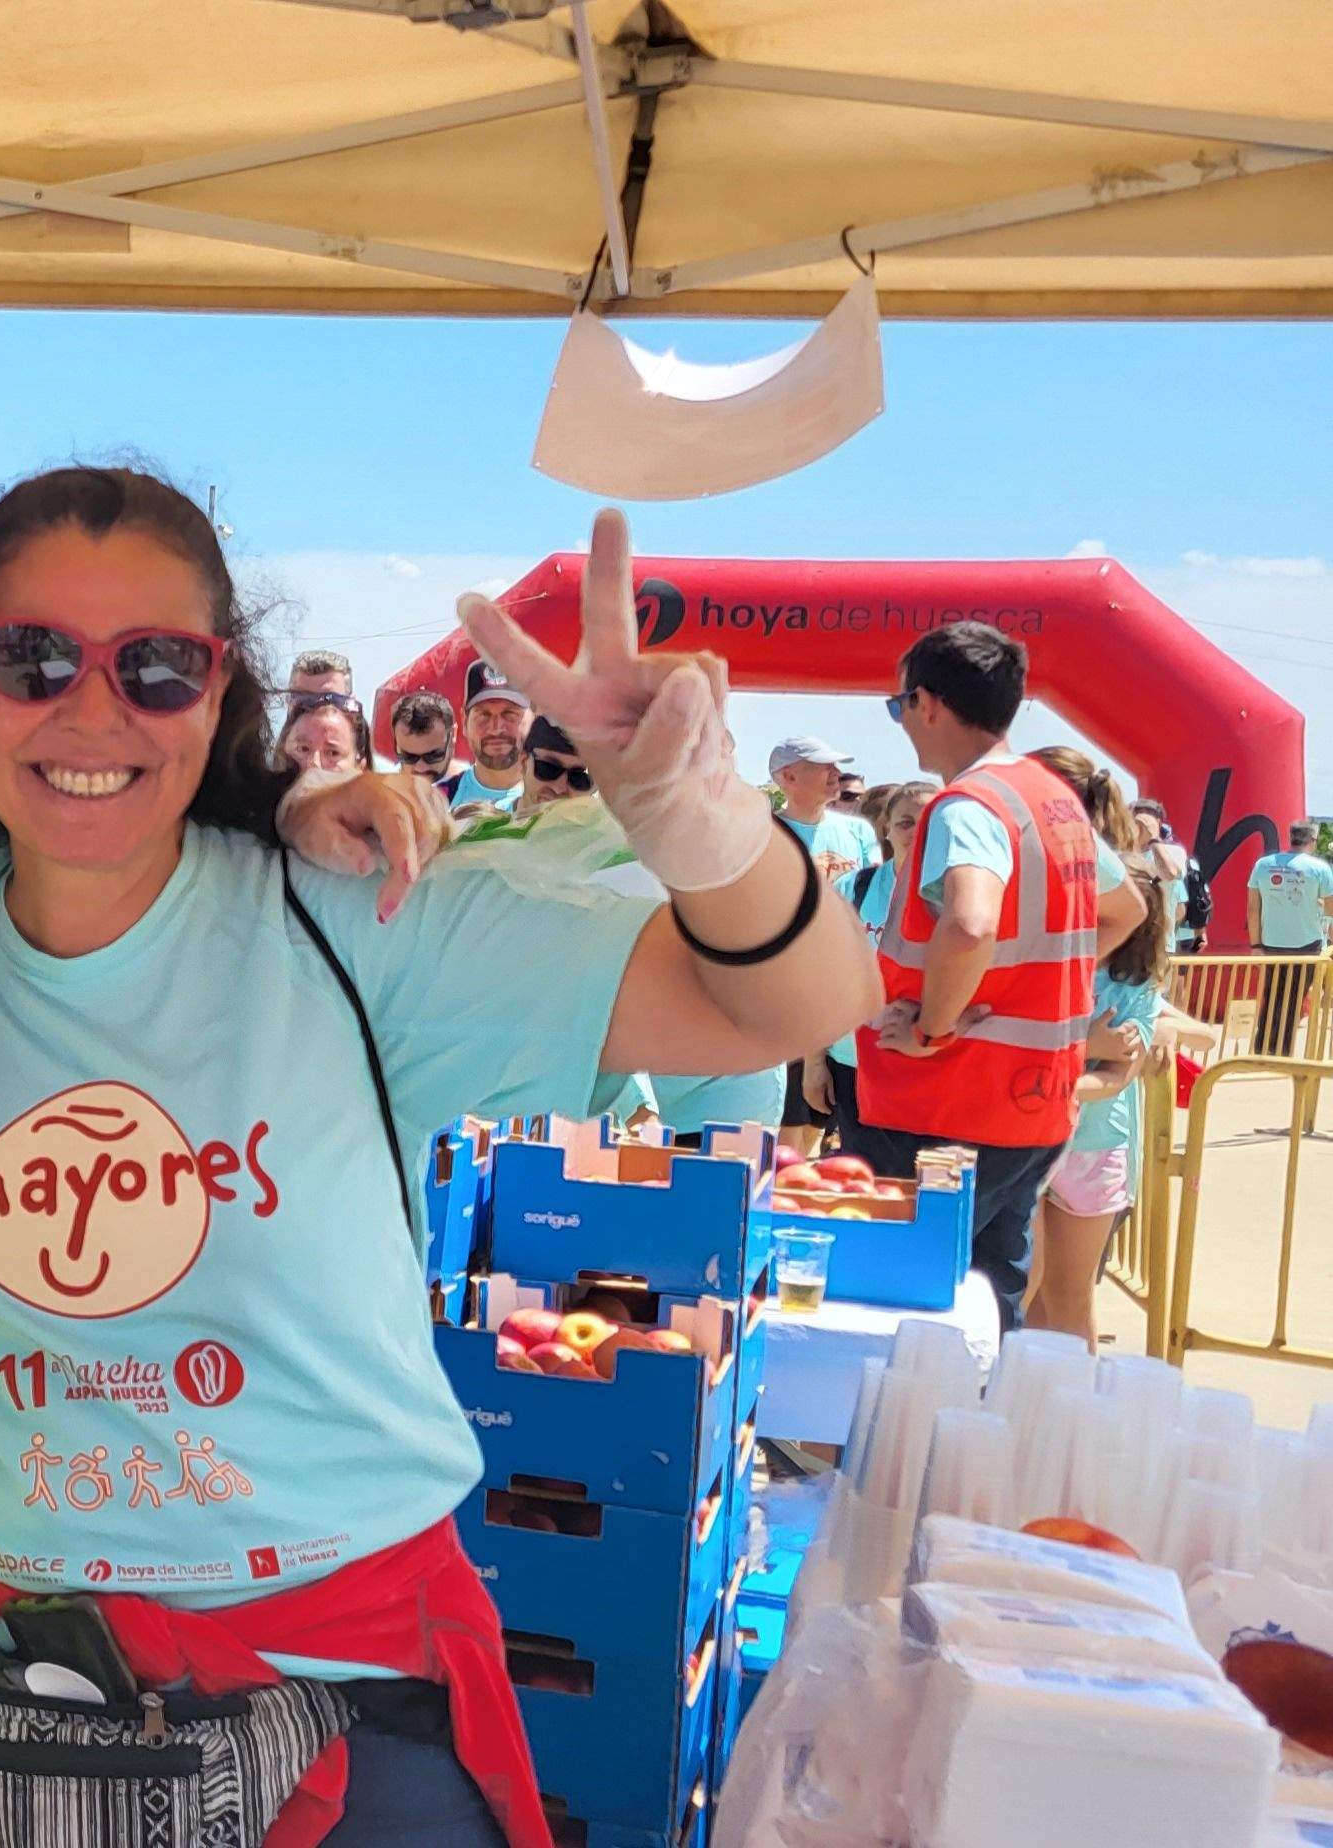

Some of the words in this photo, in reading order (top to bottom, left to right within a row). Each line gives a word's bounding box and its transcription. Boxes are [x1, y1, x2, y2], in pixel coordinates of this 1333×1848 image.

[699, 596, 809, 636] hoya
[819, 597, 871, 631] de
[881, 598, 1044, 634] huesca
[116, 1564, 155, 1578] hoya
[178, 1561, 232, 1577] huesca
